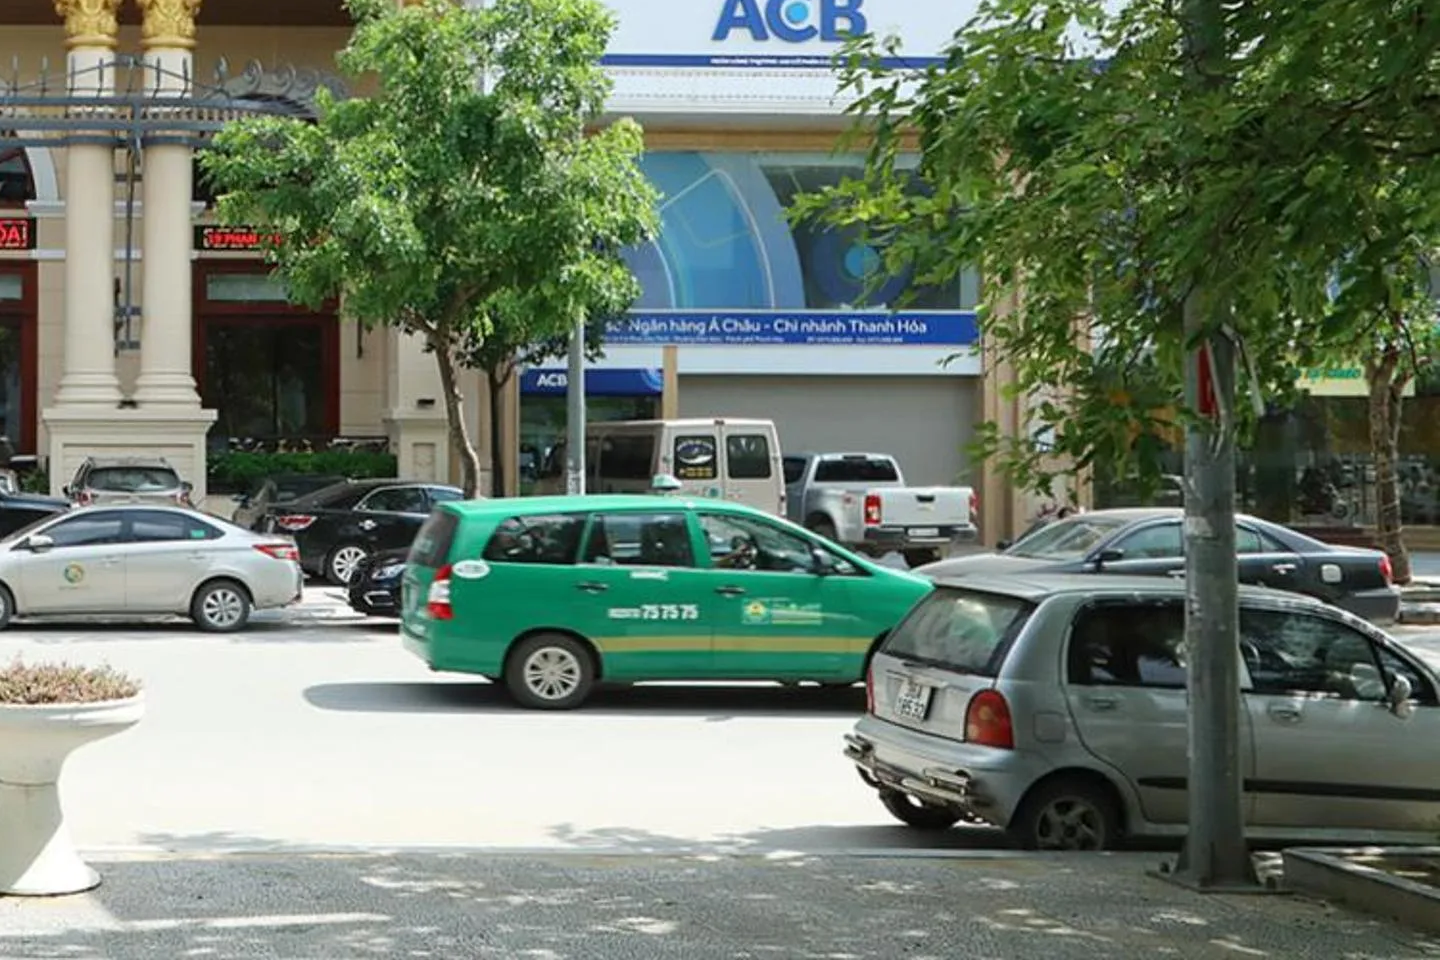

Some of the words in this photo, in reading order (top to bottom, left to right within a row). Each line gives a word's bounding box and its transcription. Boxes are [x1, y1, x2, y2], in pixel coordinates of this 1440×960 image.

[722, 318, 760, 333] Châu
[800, 318, 847, 333] nhánh
[848, 319, 895, 333] Thanh
[898, 319, 928, 334] Hóa
[536, 373, 568, 387] ACB
